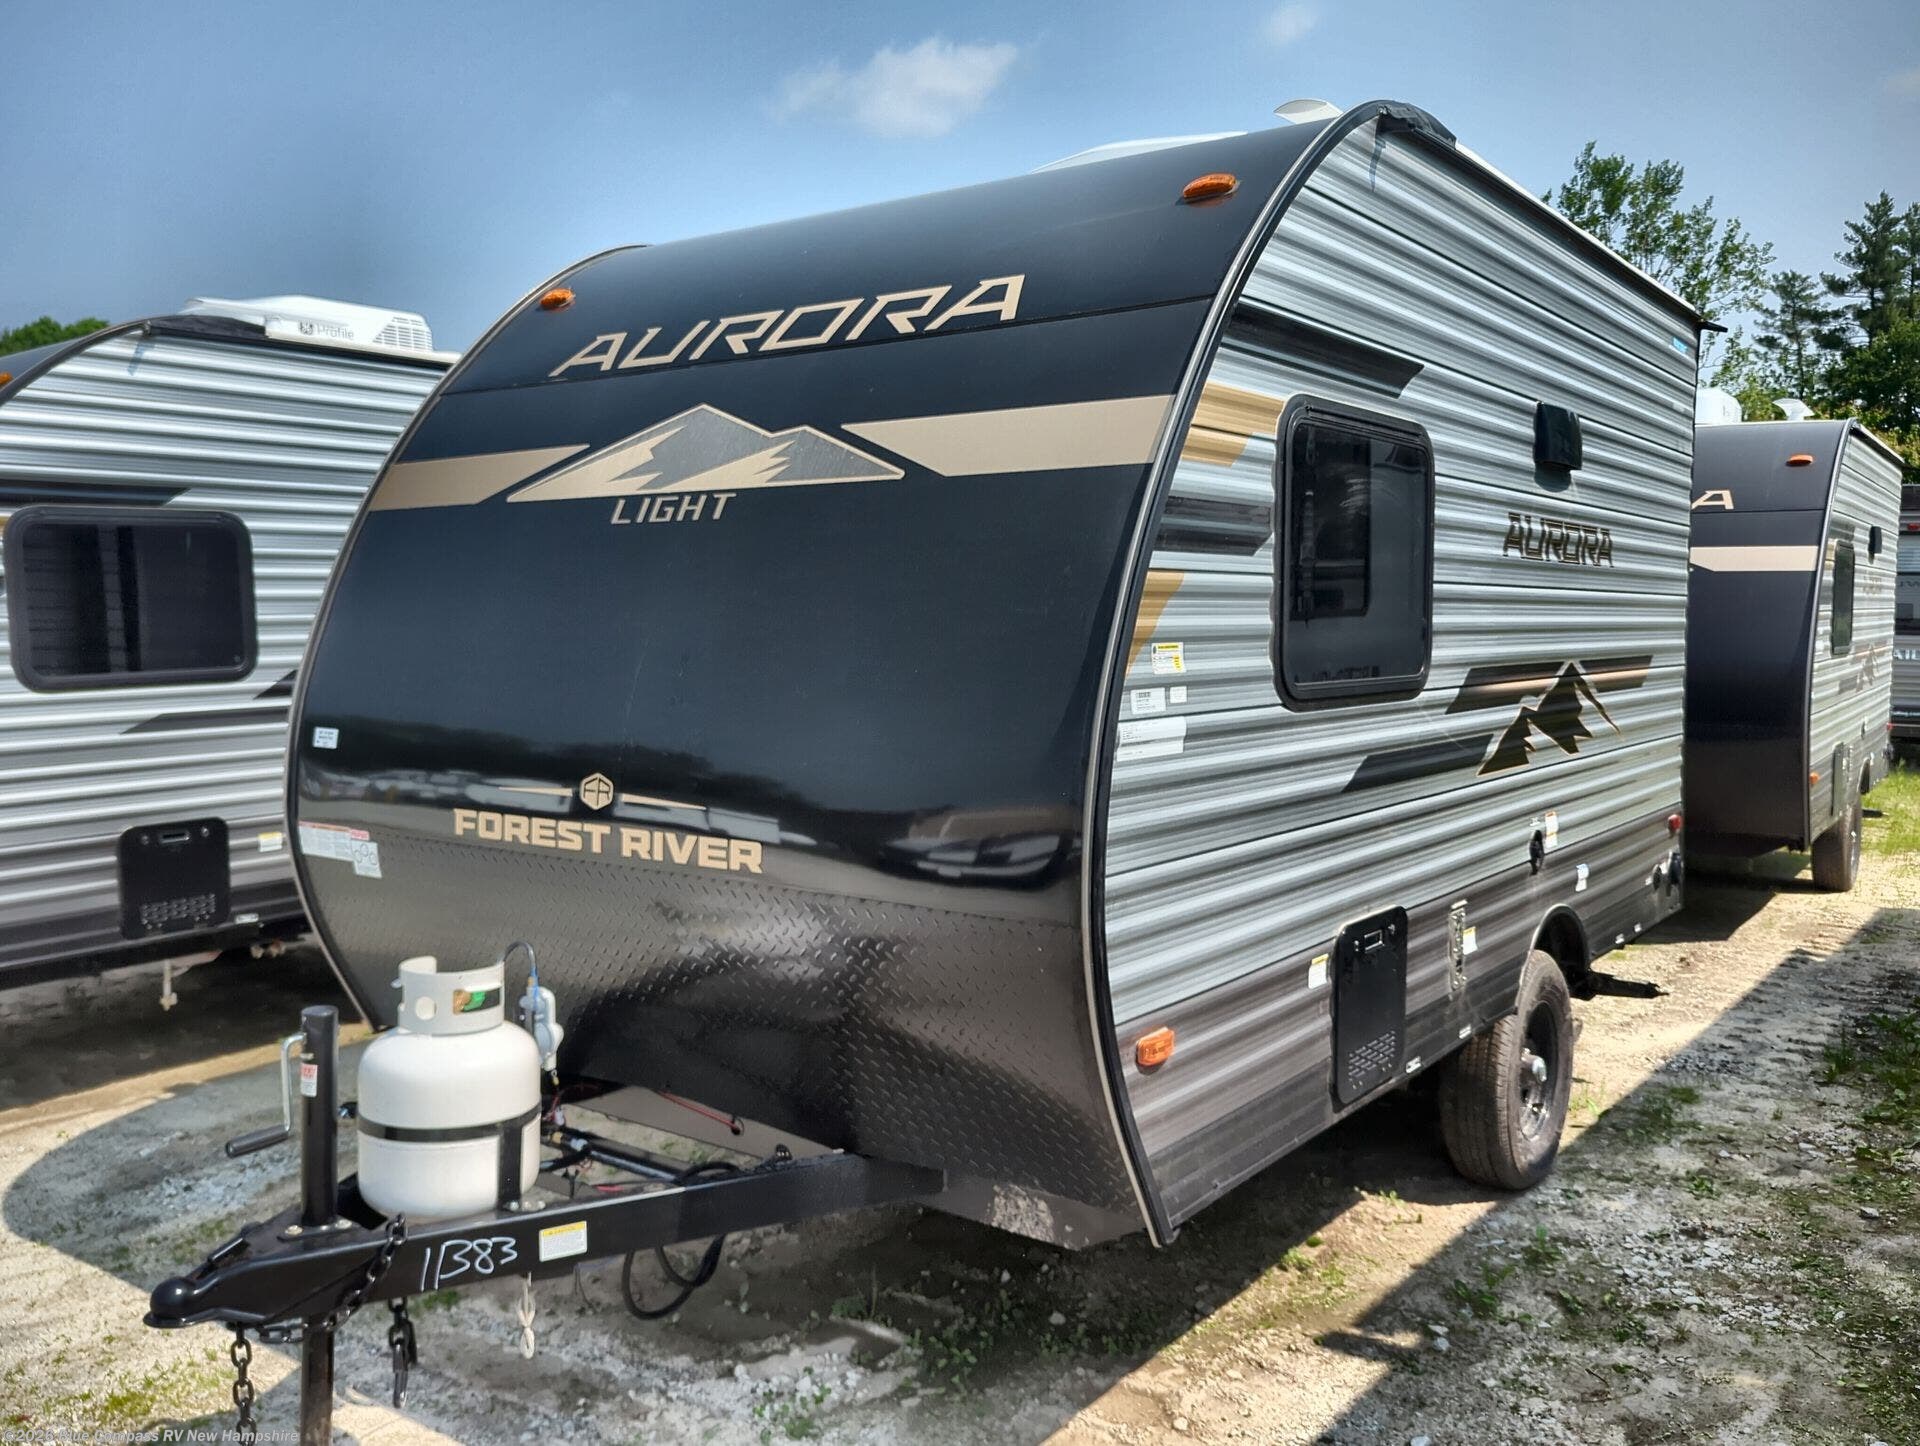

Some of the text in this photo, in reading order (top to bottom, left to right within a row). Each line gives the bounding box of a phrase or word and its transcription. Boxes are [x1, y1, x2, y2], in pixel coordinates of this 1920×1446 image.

[549, 274, 1025, 378] AURORA
[610, 492, 737, 526] LIGHT
[1502, 511, 1615, 568] AURORA
[453, 808, 764, 874] FOREST RIVER
